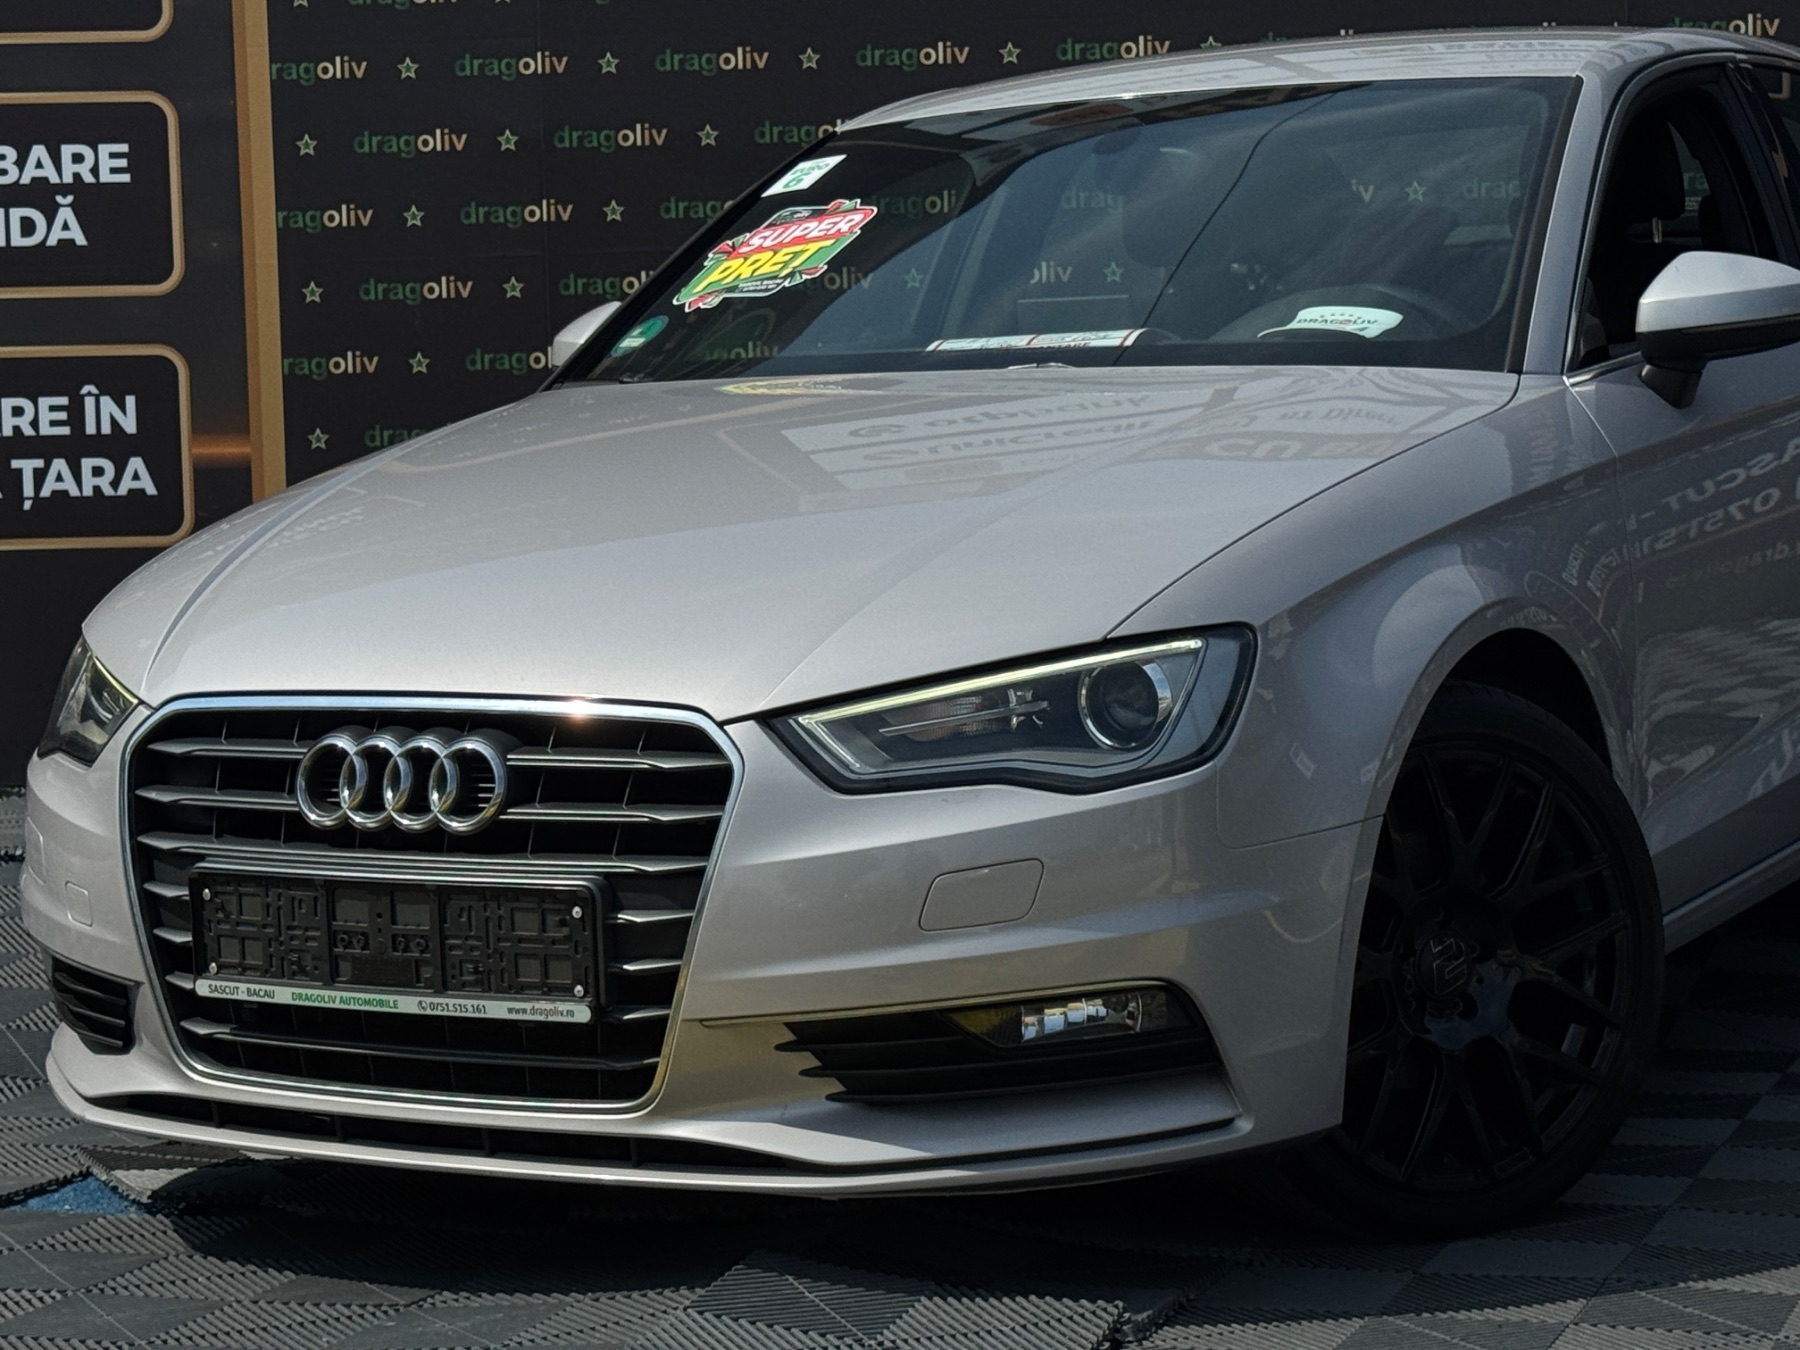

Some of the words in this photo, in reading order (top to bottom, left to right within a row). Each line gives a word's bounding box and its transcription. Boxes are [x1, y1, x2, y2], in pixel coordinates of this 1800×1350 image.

[654, 47, 769, 76] dragoliv
[856, 42, 970, 71] dragoliv
[1056, 35, 1171, 60] dragoliv
[454, 51, 568, 80] dragoliv
[353, 129, 468, 158] dragoliv
[553, 123, 668, 153] dragoliv
[460, 199, 574, 229] dragoliv
[737, 213, 866, 253] SUPER
[359, 276, 473, 305] dragoliv
[79, 384, 138, 436] ÎN
[10, 457, 158, 511] ȚARA
[208, 983, 240, 996] SASCUT
[246, 987, 276, 999] BACAU
[291, 992, 337, 1006] DRAGOLIV
[338, 996, 399, 1010] AUTOMOBILE
[507, 1005, 576, 1020] www.dragoliv.ro
